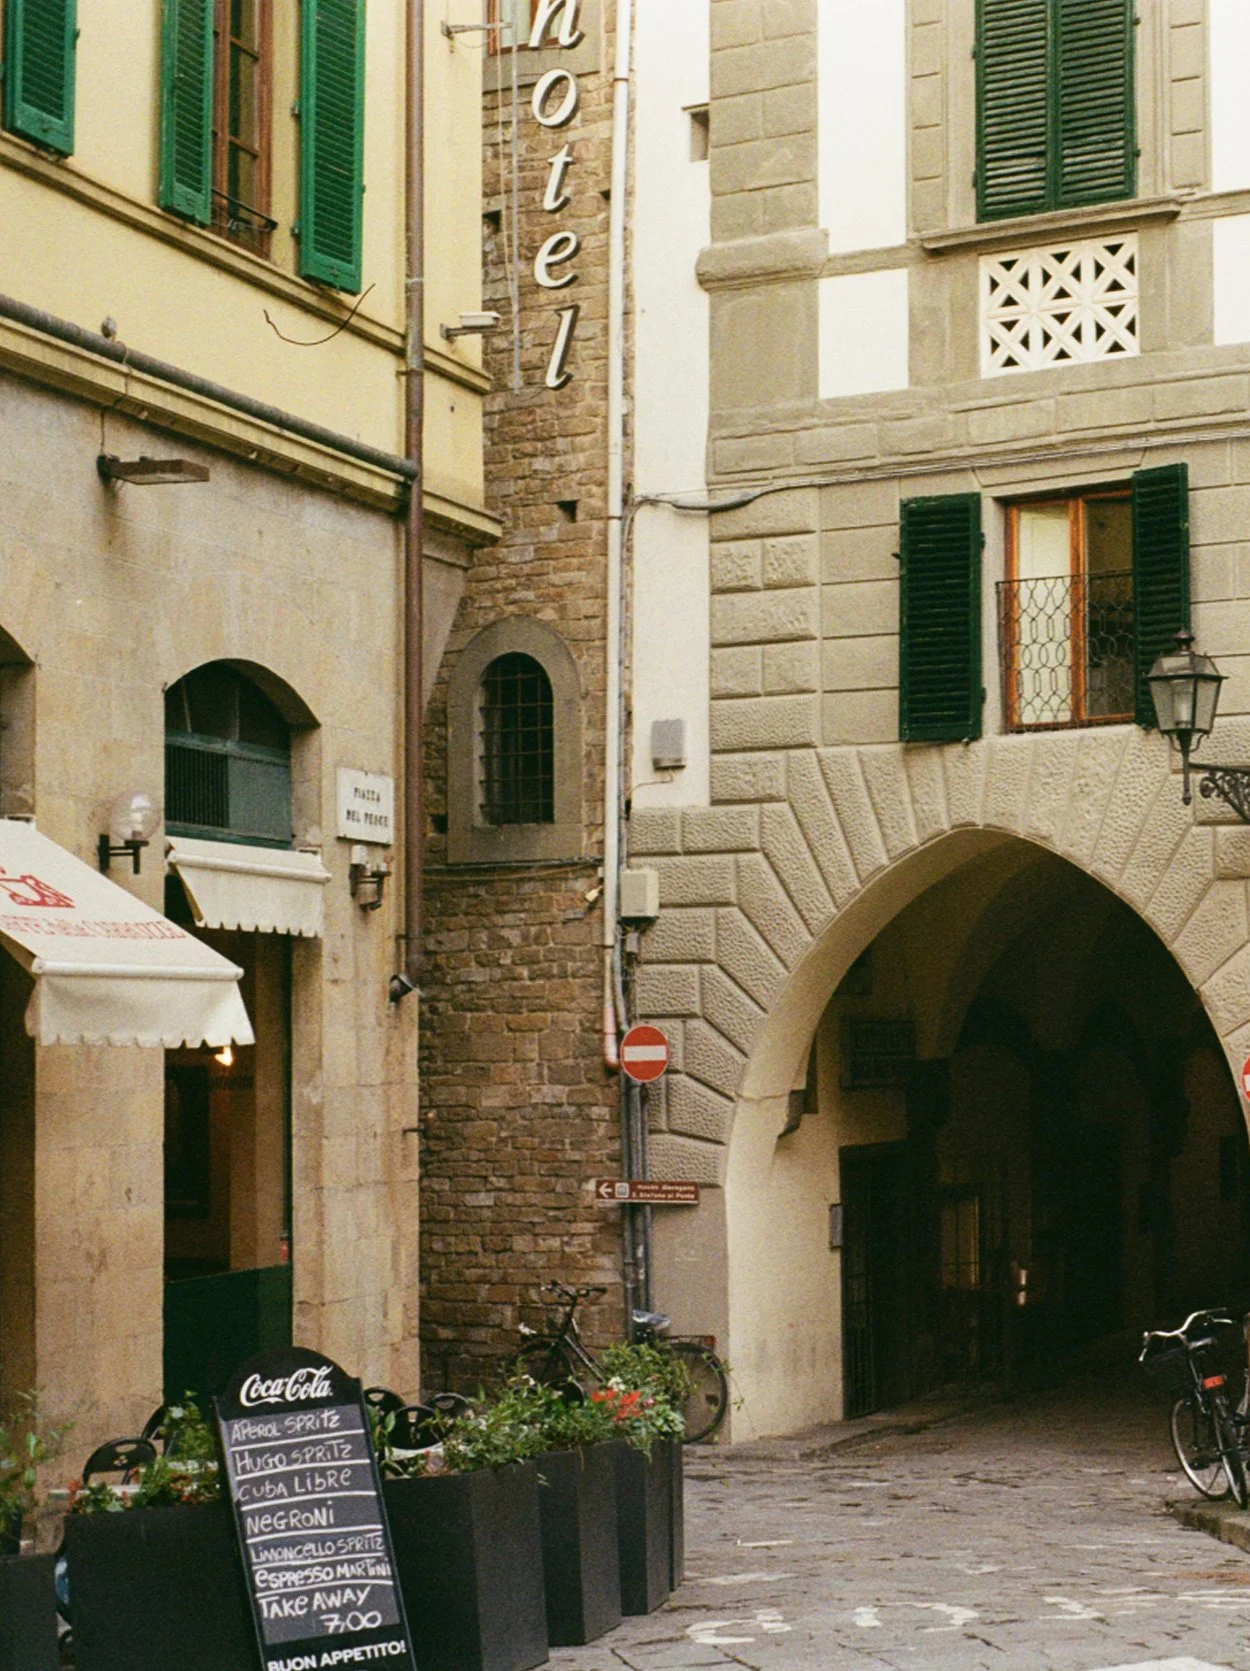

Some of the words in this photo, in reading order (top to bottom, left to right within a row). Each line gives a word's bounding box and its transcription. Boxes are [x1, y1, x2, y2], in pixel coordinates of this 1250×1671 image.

[354, 787, 380, 803] PIAZZA
[346, 809, 360, 823] DEL
[364, 812, 388, 827] PESCE
[240, 1365, 334, 1407] Coca-Cola
[235, 1451, 287, 1474] HUGO
[312, 1585, 371, 1611] AWAY
[320, 1610, 382, 1634] 7,00
[267, 1654, 317, 1671] BUON
[320, 1640, 406, 1667] APPETITO!
